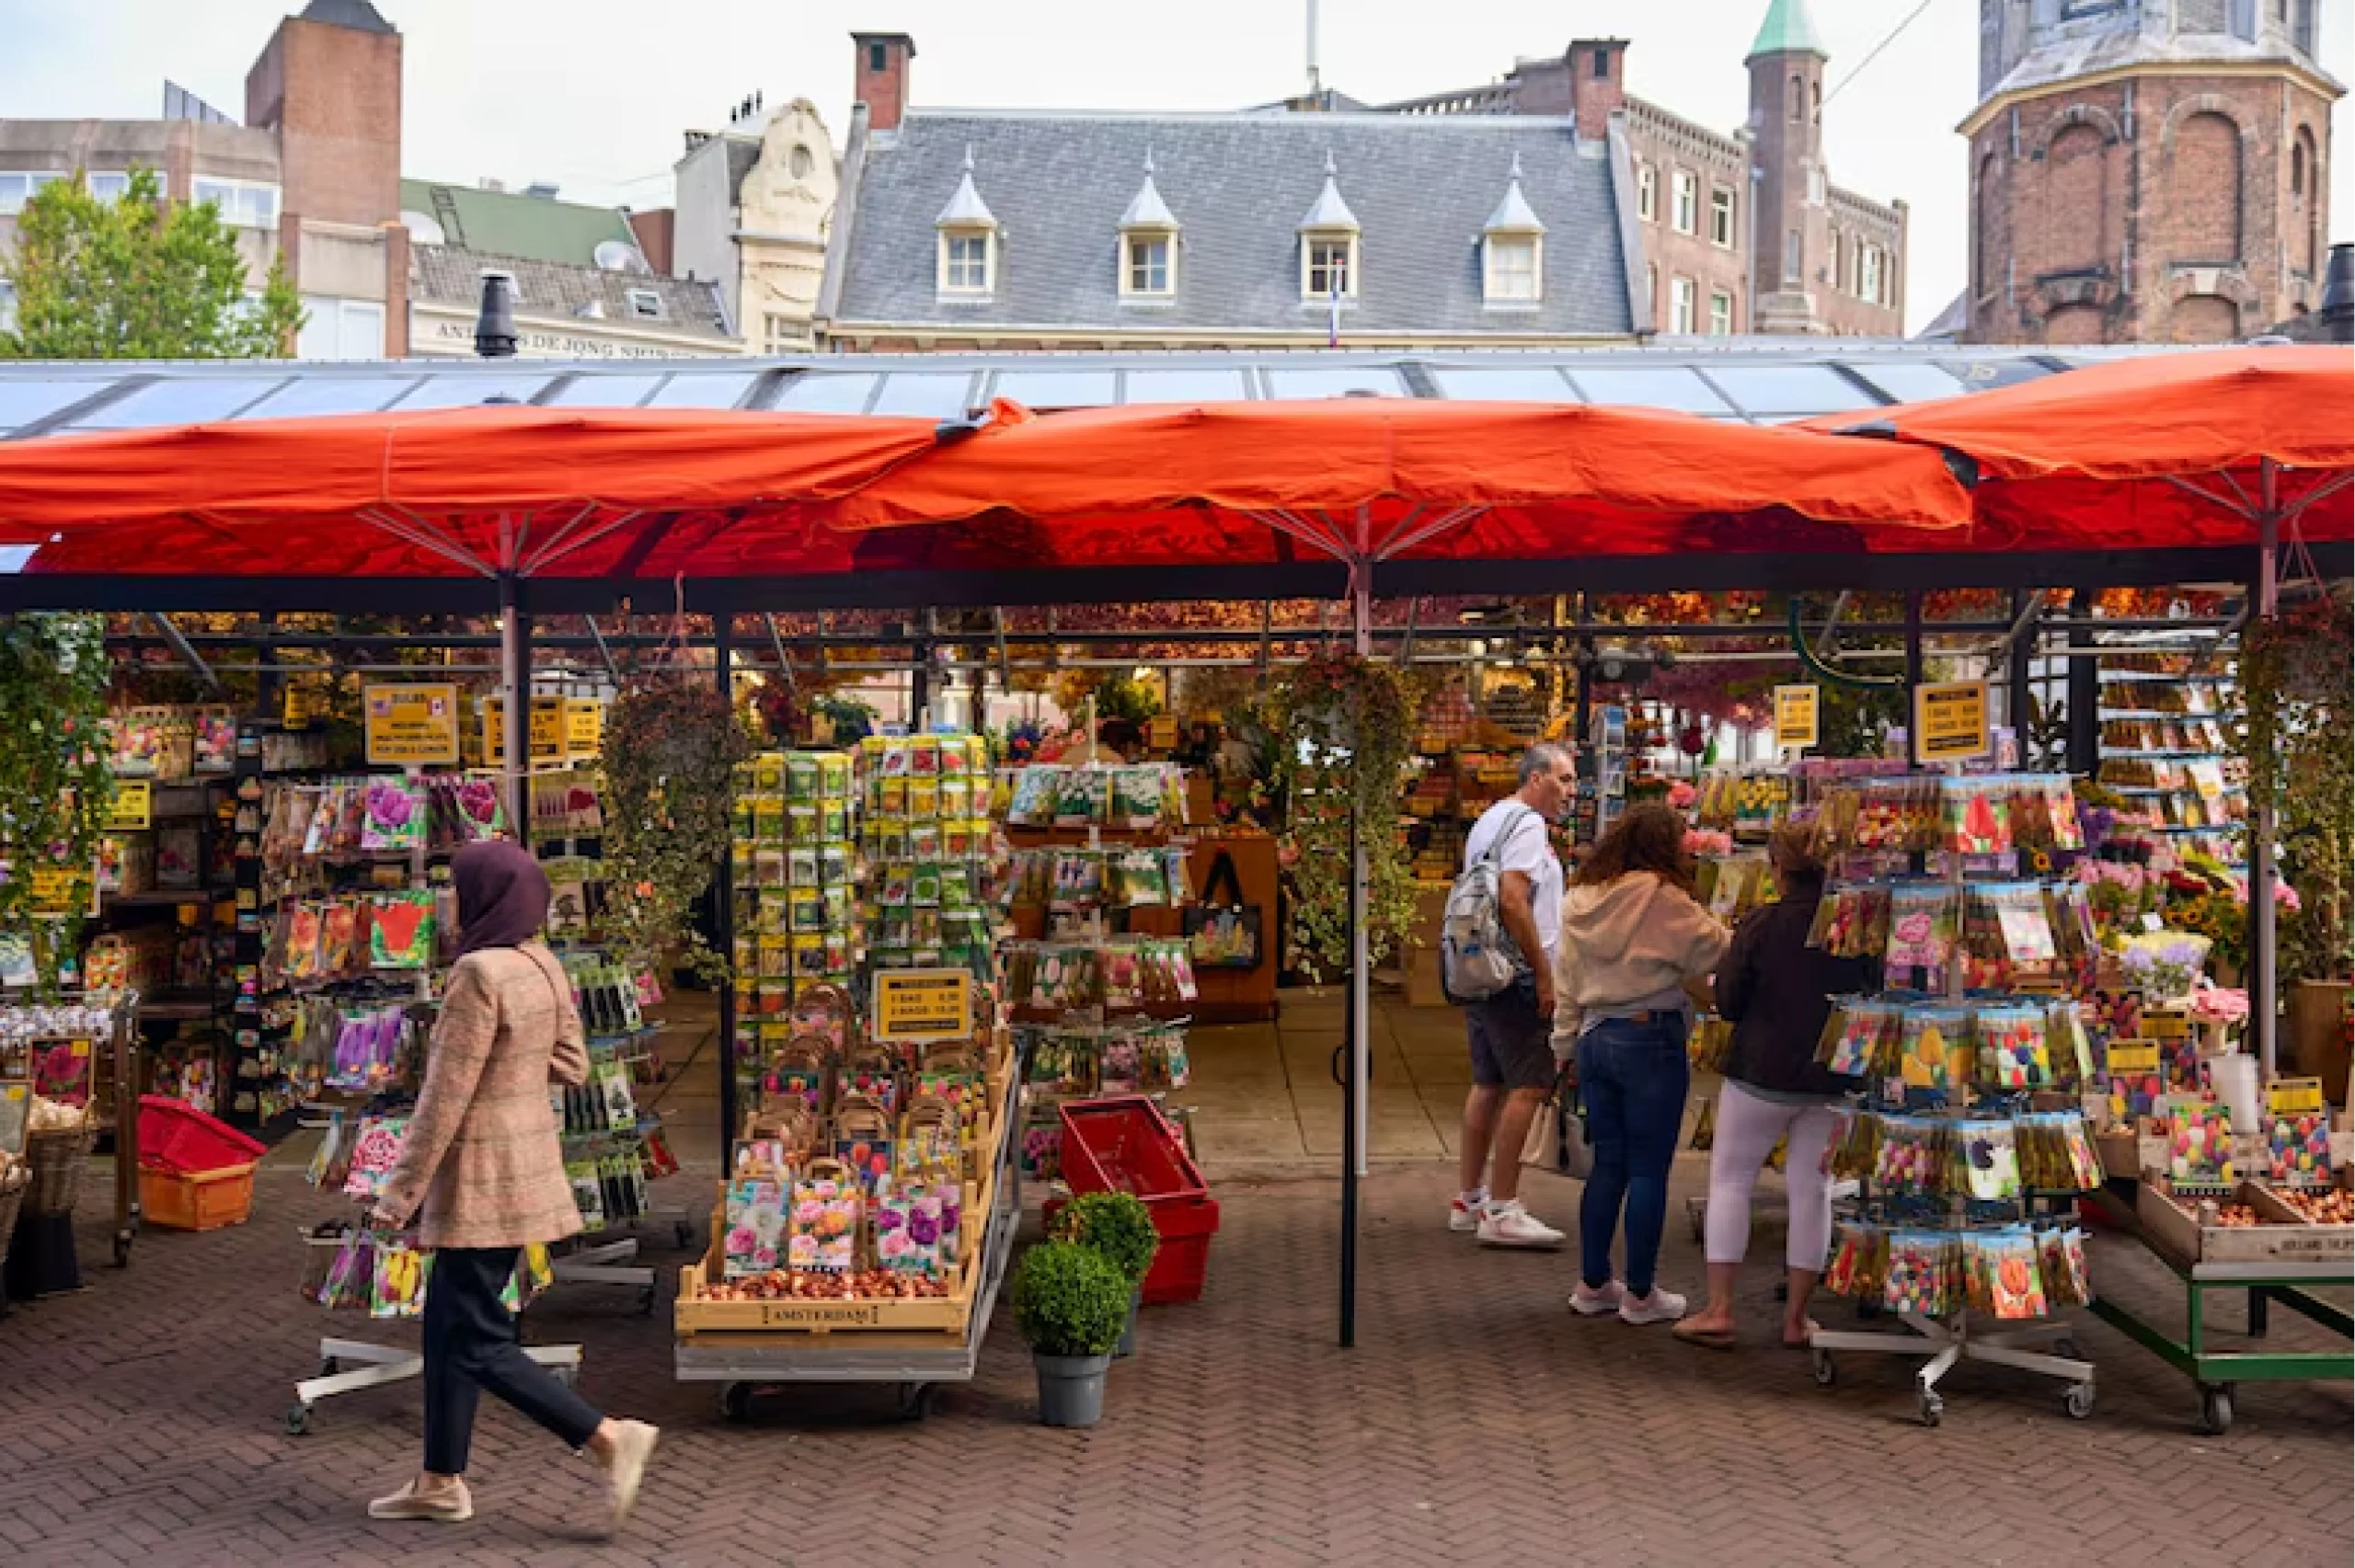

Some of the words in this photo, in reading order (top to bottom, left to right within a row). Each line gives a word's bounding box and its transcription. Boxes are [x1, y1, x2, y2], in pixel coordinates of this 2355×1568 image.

[534, 335, 560, 350] DE
[561, 338, 614, 358] JONG
[774, 1309, 869, 1322] AMSTERDAM
